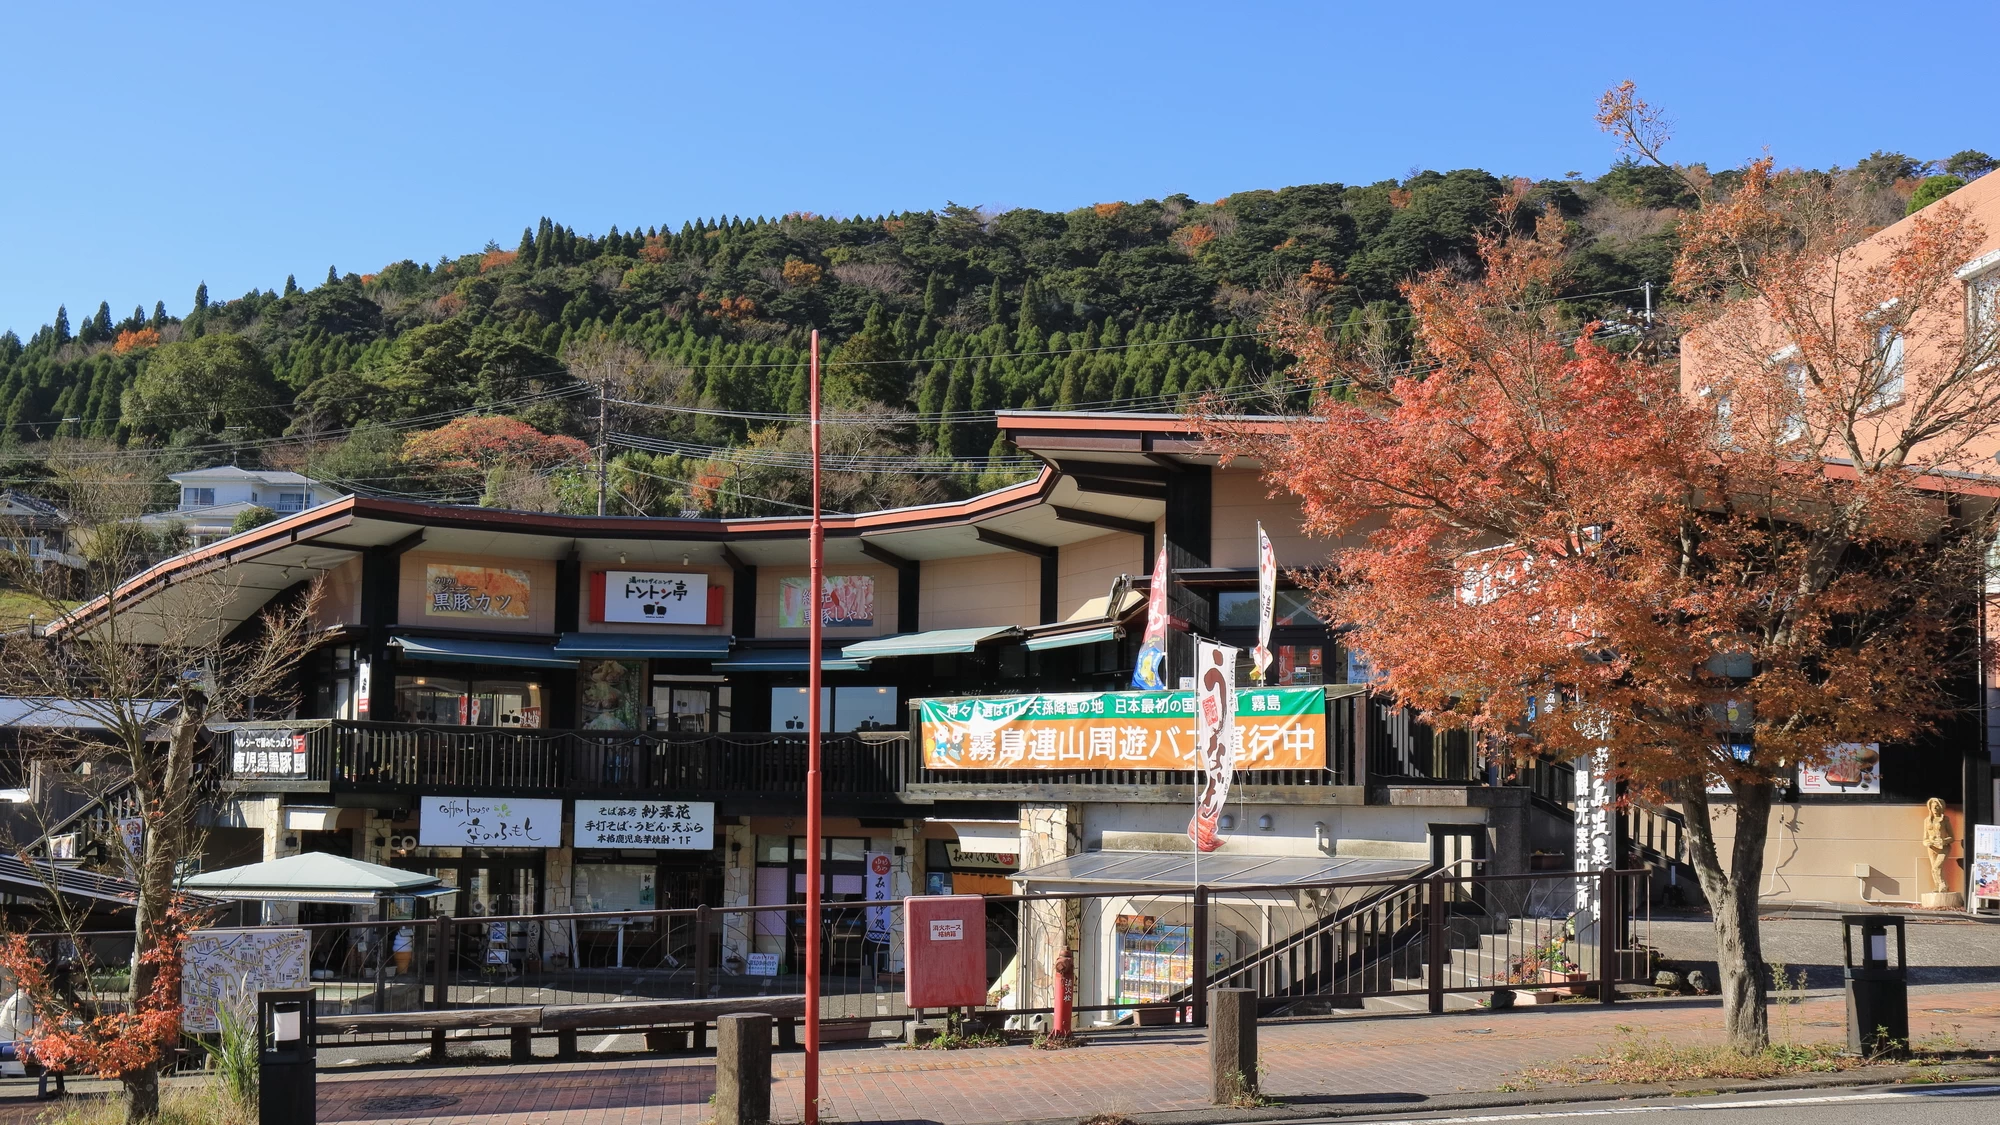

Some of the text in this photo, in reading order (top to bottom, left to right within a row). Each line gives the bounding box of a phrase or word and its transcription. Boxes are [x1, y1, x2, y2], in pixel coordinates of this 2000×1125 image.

[434, 577, 458, 585] カリカリ
[442, 585, 478, 593] ジューシー
[625, 580, 688, 602] トントン亭
[433, 593, 512, 612] 黒豚カツ
[1251, 694, 1281, 712] 霧島
[233, 751, 292, 773] 鹿児島黒豚
[1807, 775, 1820, 783] 2F
[598, 806, 637, 817] そば茶房
[1576, 769, 1591, 911] 観光案内所
